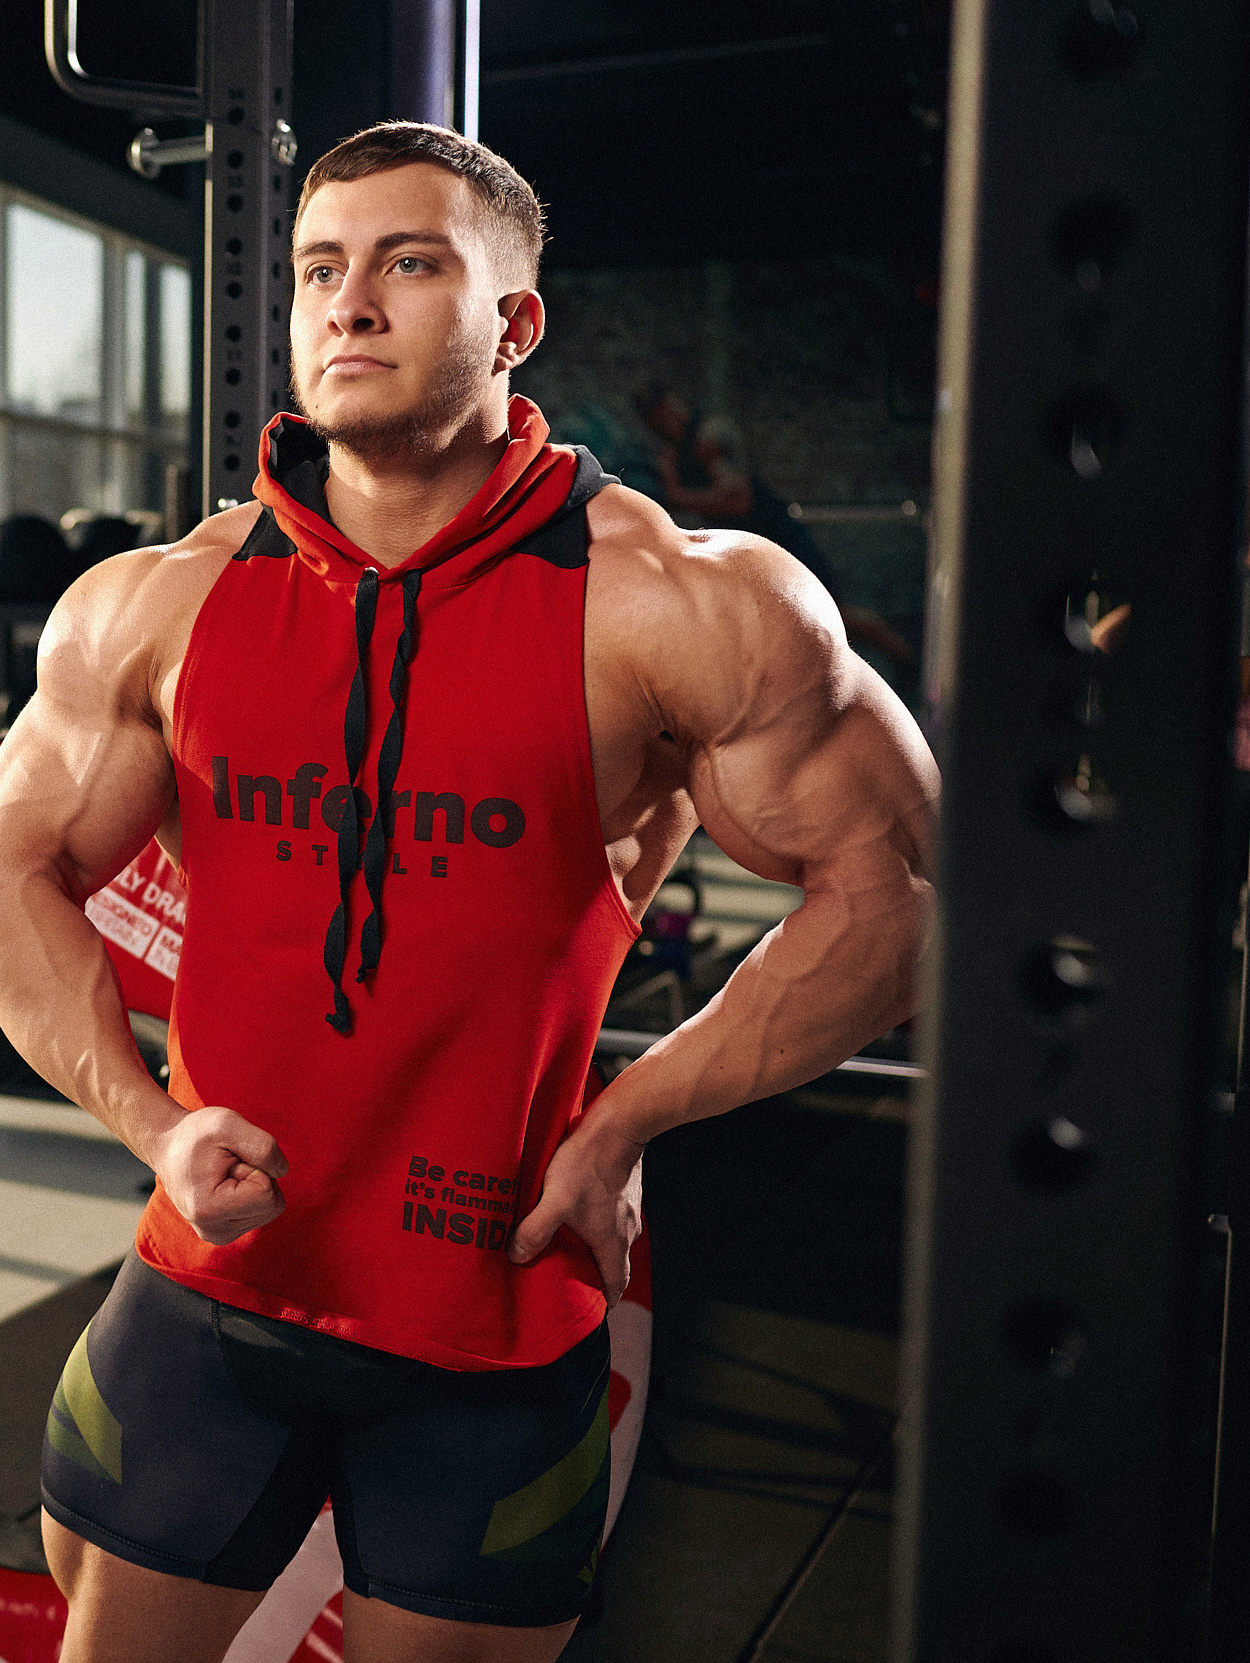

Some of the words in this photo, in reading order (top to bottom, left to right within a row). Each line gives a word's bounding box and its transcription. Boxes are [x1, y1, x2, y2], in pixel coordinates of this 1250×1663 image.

[211, 755, 527, 849] Inferno
[275, 839, 449, 879] STLE
[142, 881, 186, 926] DRA
[405, 1178, 435, 1199] it's
[408, 1155, 445, 1182] Be
[402, 1200, 510, 1251] INSID
